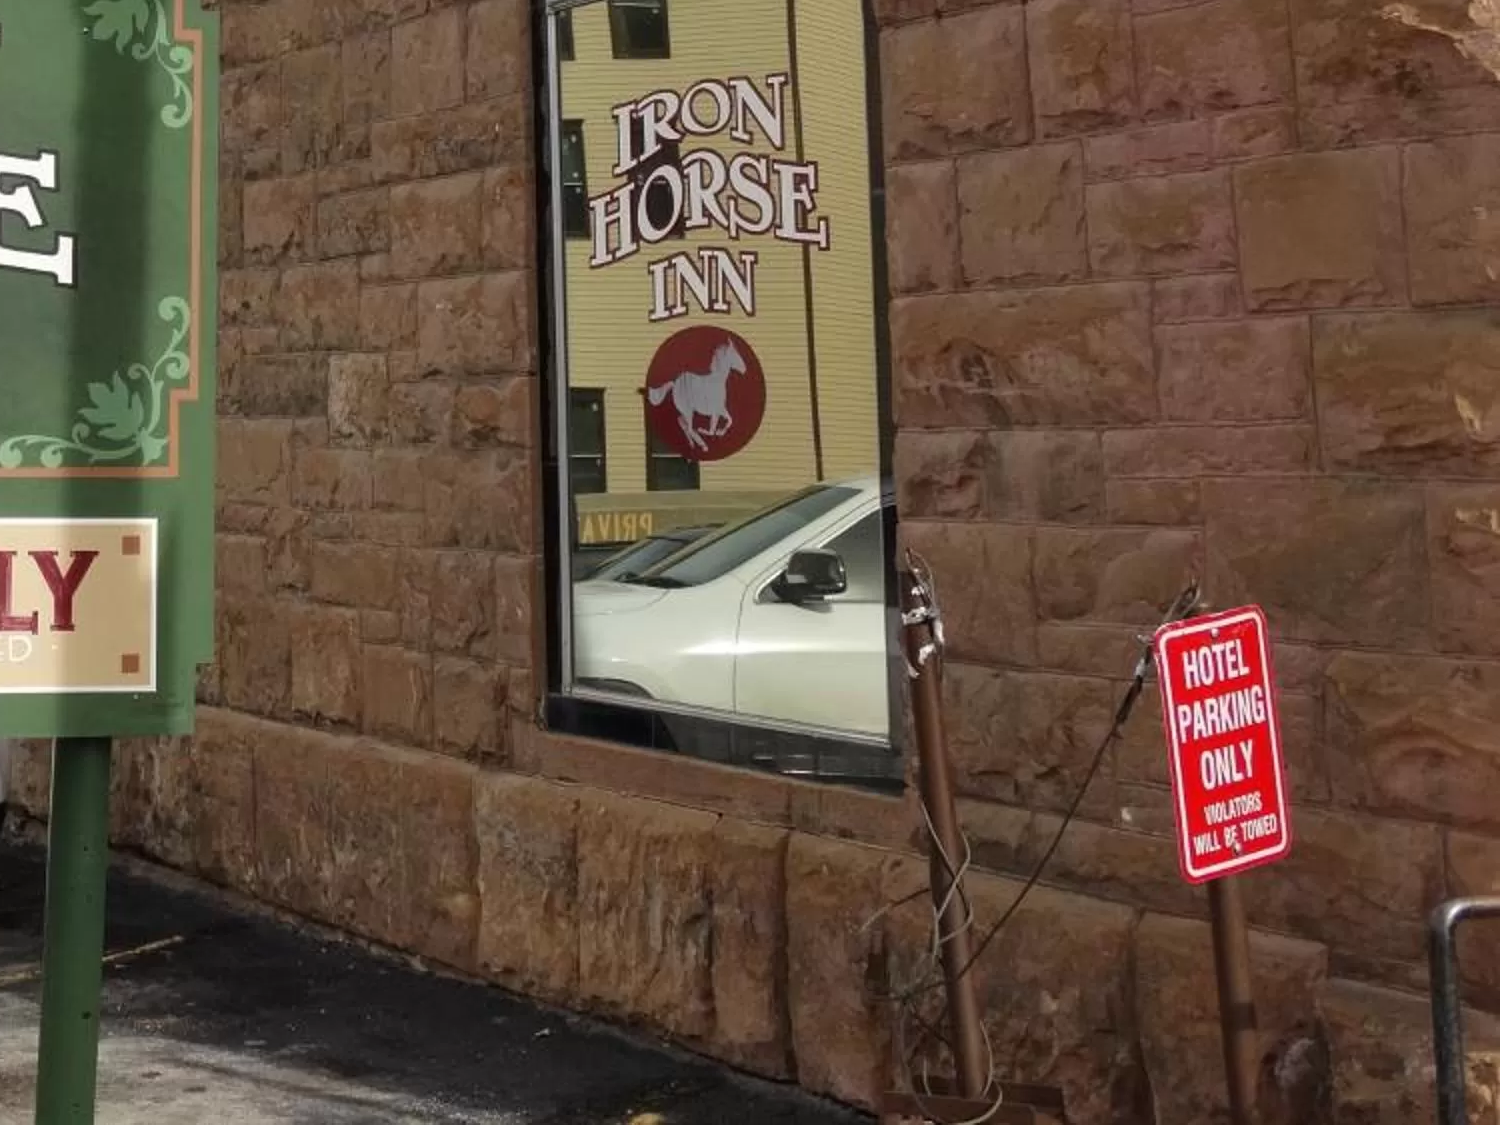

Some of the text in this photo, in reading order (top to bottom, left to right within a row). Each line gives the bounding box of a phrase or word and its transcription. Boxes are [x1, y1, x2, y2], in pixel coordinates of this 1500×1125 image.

[611, 73, 788, 177] IRON
[588, 148, 830, 268] HORSE
[648, 246, 758, 321] INN
[1182, 638, 1250, 689] HOTEL
[1177, 685, 1266, 744] PARKING
[1200, 740, 1254, 790] ONLY
[1194, 813, 1278, 856] WILL BE TOWED
[1203, 791, 1263, 826] VIOLATORS
